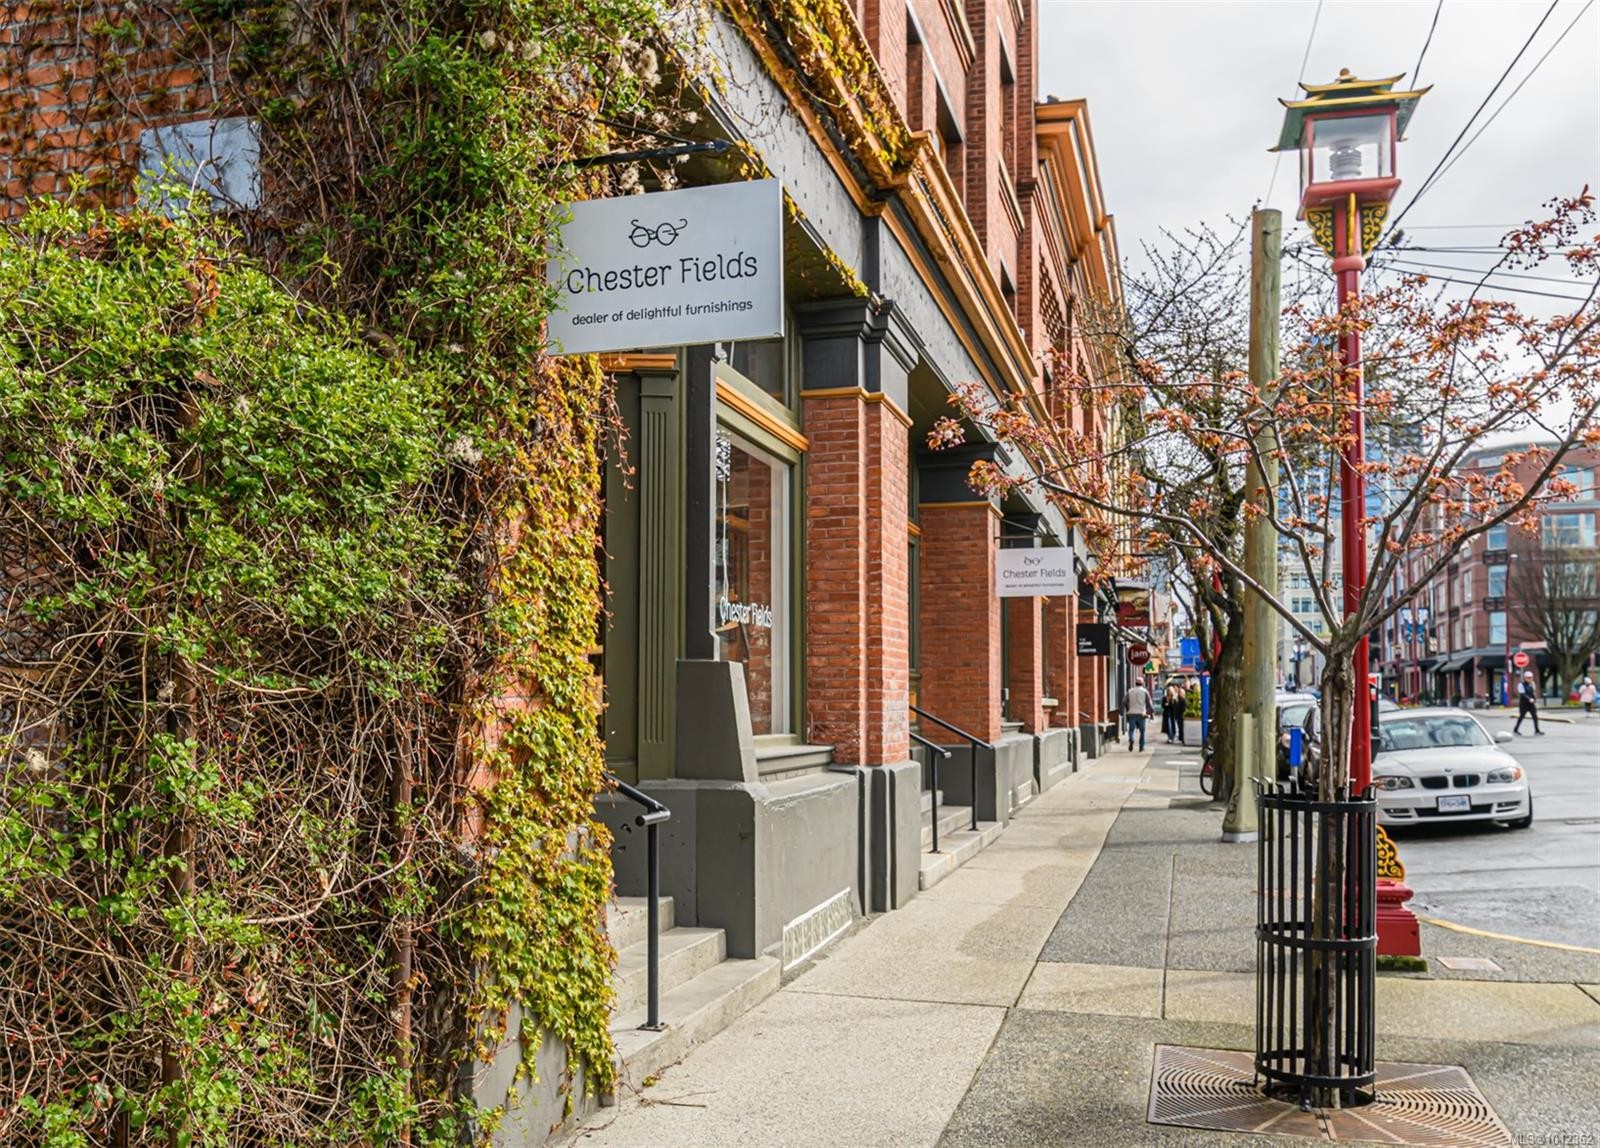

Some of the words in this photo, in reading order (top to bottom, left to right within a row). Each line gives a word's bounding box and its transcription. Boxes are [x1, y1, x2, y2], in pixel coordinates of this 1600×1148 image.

[567, 264, 672, 294] Chester
[679, 251, 758, 284] Fields
[572, 312, 609, 326] dealer
[611, 309, 624, 322] of
[626, 305, 682, 321] delightful
[686, 299, 753, 316] furnishings
[1003, 569, 1038, 579] Chester
[1040, 568, 1066, 578] Fields
[720, 596, 751, 625] Chester
[751, 602, 773, 628] Fields
[1131, 649, 1148, 660] jam
